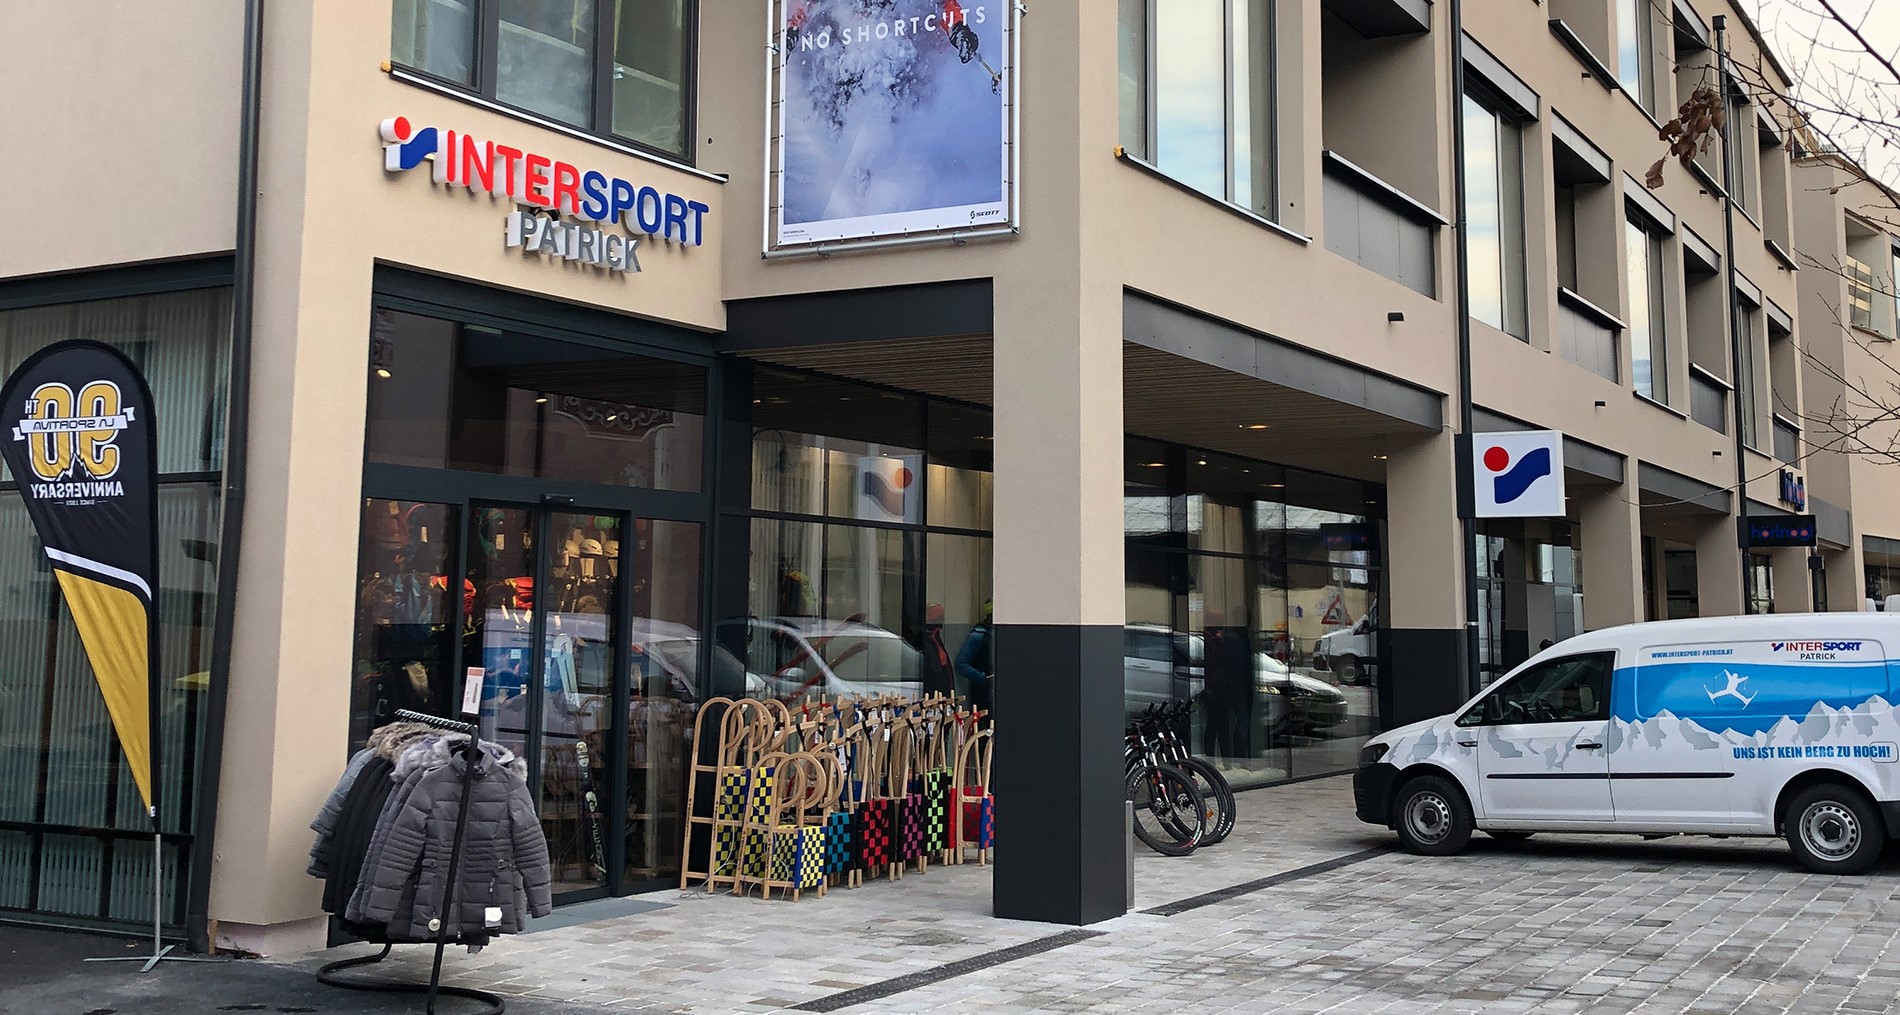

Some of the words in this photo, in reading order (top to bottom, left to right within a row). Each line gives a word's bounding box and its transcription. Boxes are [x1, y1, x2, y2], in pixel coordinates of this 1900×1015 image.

[801, 32, 830, 52] NO
[842, 6, 987, 46] SHORTCUTS
[445, 129, 710, 247] INTERSPORT
[976, 209, 1000, 217] SCOTT
[519, 211, 642, 273] PATRICK
[1651, 648, 1734, 659] WWW.INTERSPORT-PATRICK.AT
[1785, 641, 1862, 652] INTERSPORT
[1733, 747, 1755, 759] UNS
[1758, 747, 1775, 758] IST
[1778, 746, 1802, 758] KEIN
[1805, 745, 1834, 758] BERG
[1837, 745, 1850, 758] ZU
[1853, 745, 1891, 758] HOCH!
